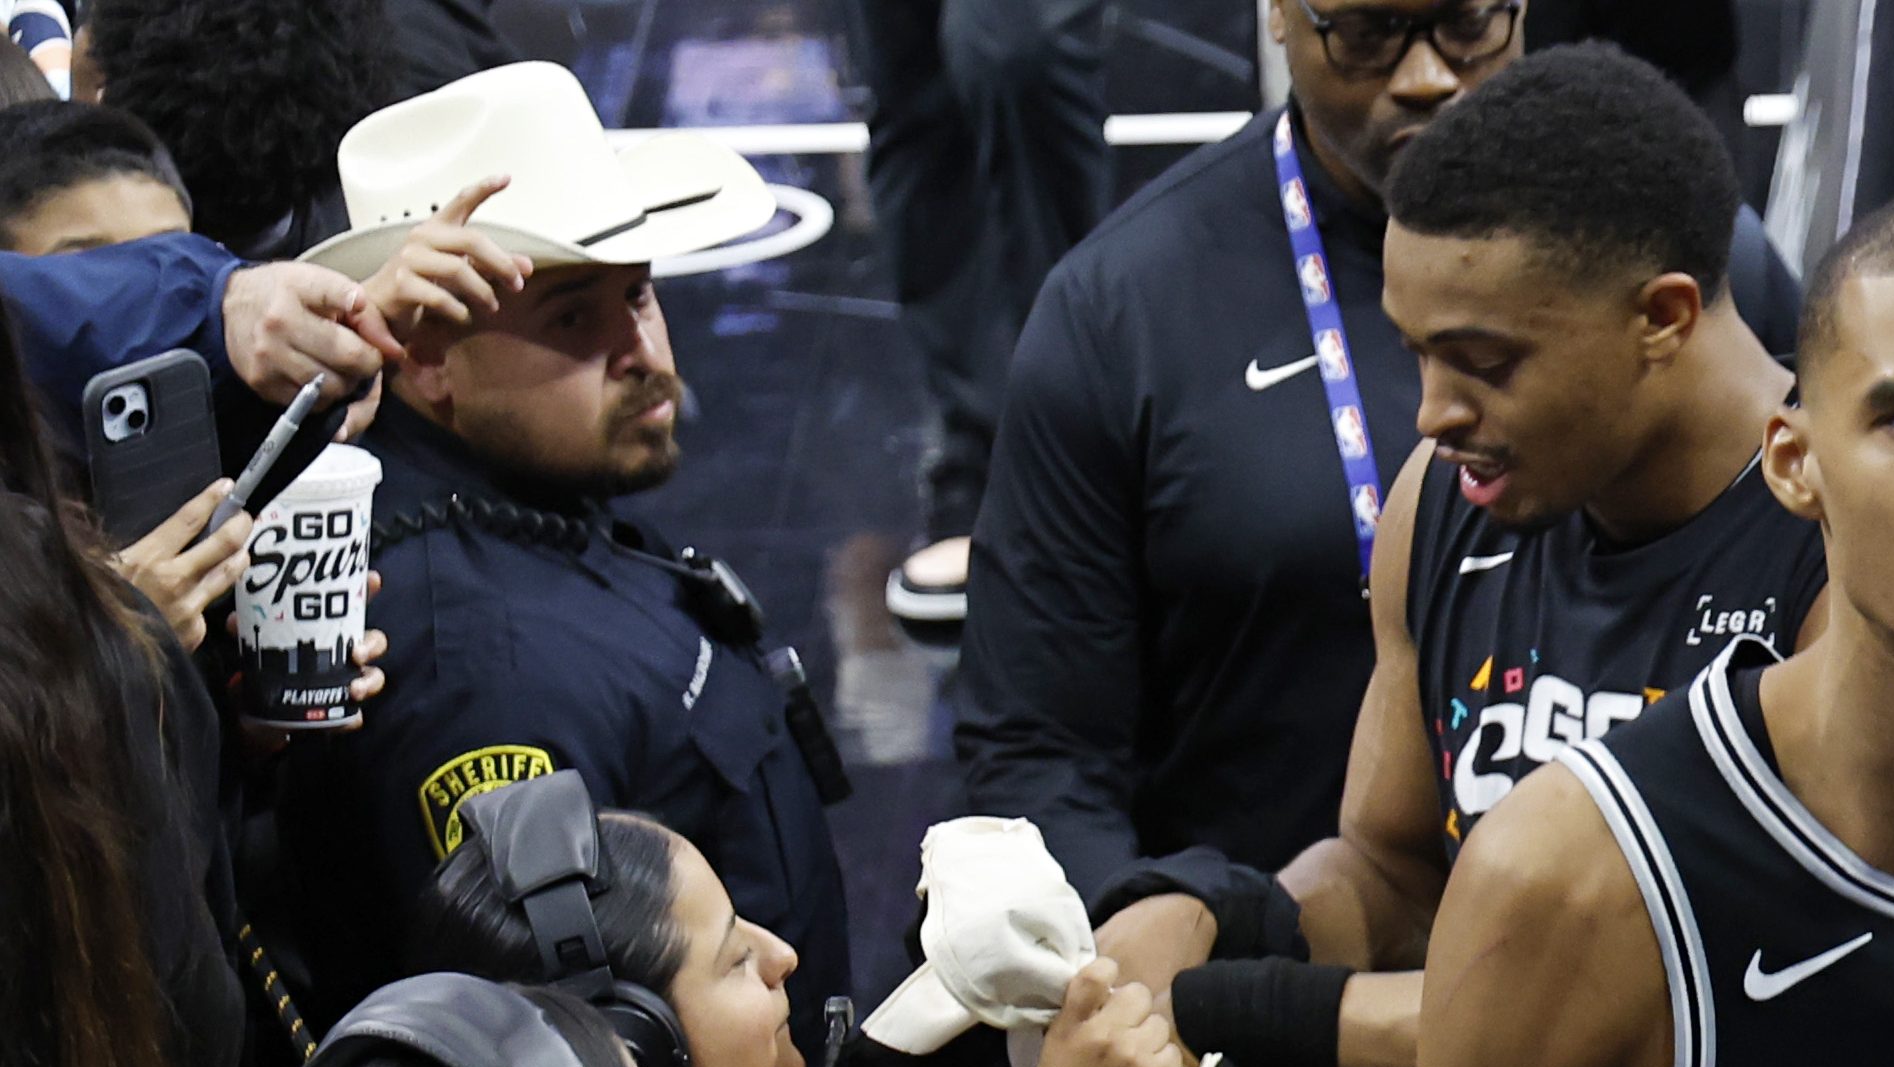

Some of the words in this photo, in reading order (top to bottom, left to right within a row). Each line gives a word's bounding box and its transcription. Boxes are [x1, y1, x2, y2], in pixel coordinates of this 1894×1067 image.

[293, 511, 352, 540] GO
[294, 590, 349, 620] GO
[428, 754, 546, 807] SHERIFF
